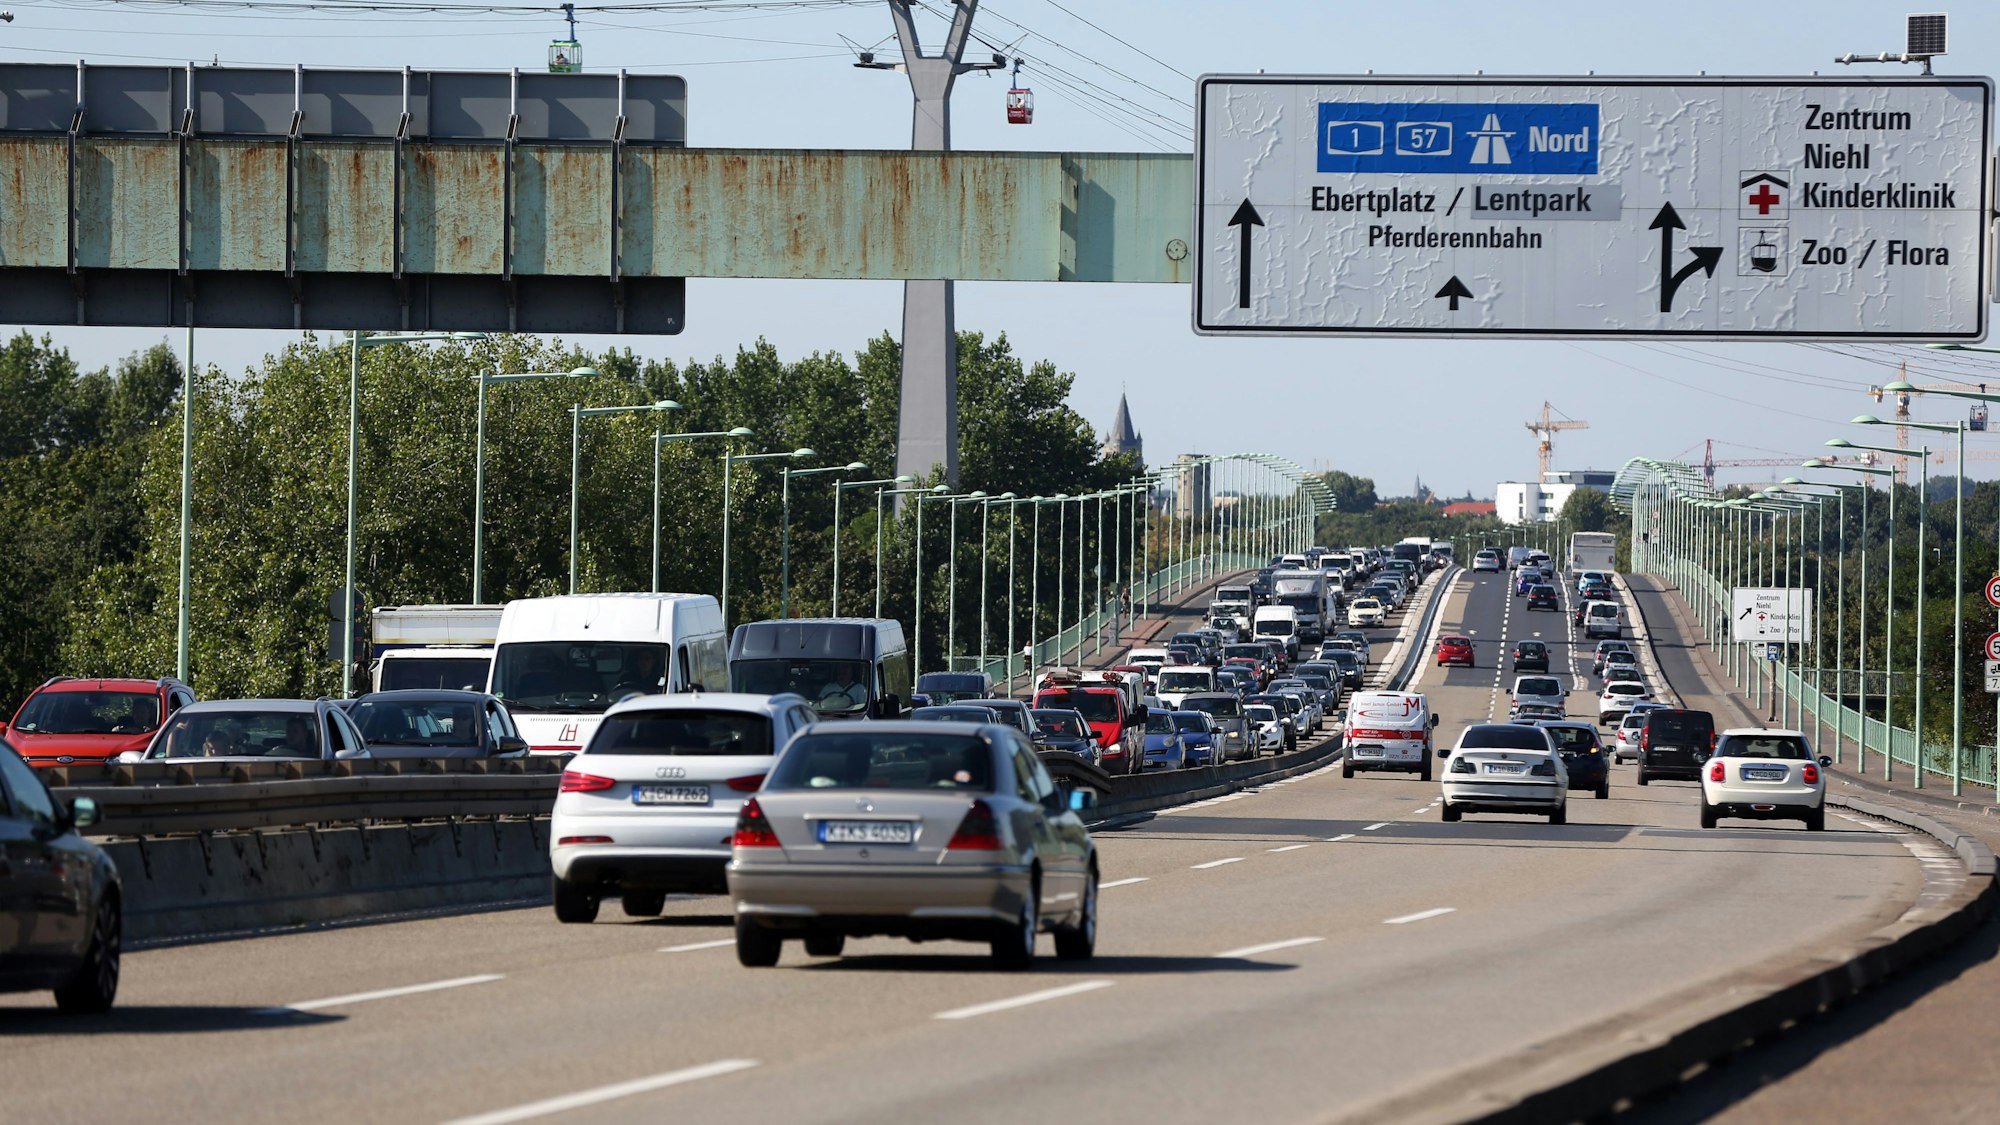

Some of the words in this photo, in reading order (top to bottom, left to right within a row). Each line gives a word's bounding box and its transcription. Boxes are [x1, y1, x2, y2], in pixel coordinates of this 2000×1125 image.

[1805, 104, 1911, 131] Zentrum
[1351, 128, 1359, 148] 1
[1411, 128, 1438, 149] 57
[1529, 126, 1589, 152] Nord
[1804, 143, 1870, 170] Niehl
[1311, 186, 1436, 216] Ebertplatz
[1446, 187, 1465, 215] /
[1474, 186, 1592, 215] Lentpark
[1803, 182, 1956, 209] Kinderklinik
[1368, 225, 1542, 249] Pferderennbahn
[1801, 239, 1847, 265] Zoo
[1857, 239, 1877, 269] /
[1887, 239, 1950, 266] Flora
[1993, 585, 2000, 598] 8
